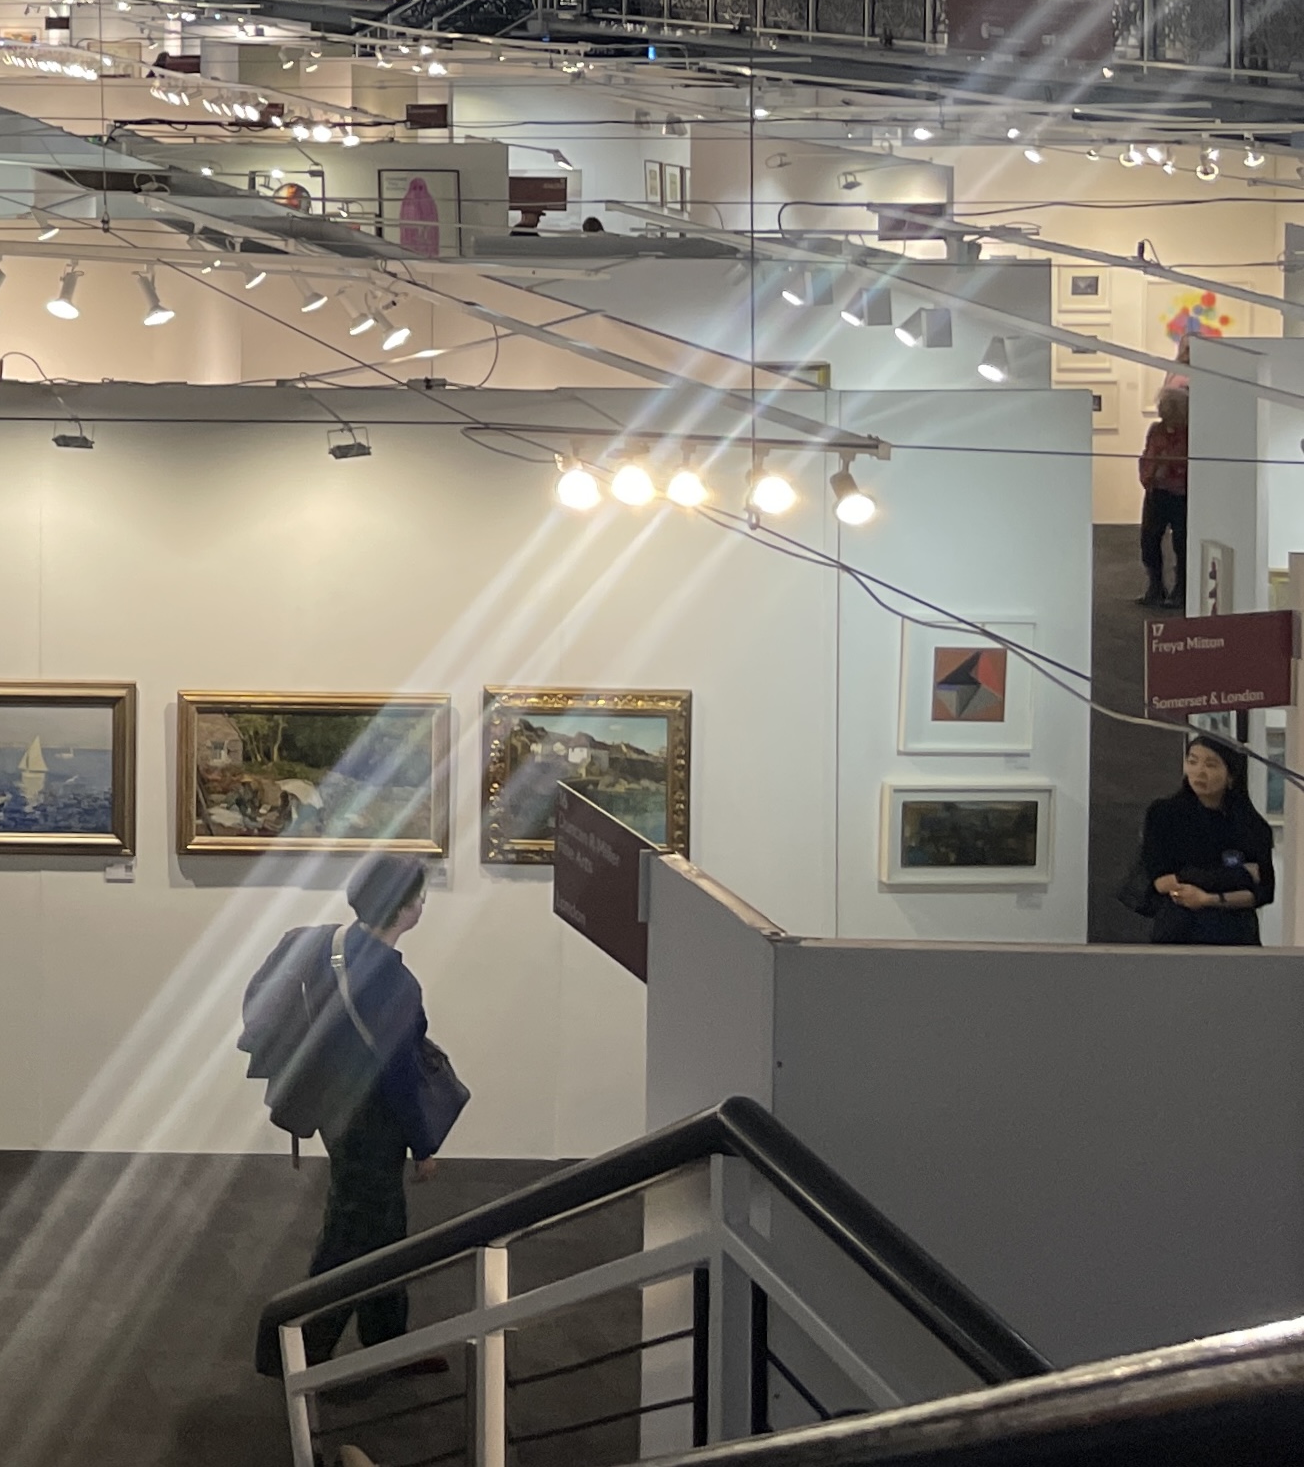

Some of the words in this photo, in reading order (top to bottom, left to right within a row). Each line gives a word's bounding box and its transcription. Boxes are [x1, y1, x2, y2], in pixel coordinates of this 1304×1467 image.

[1152, 623, 1165, 636] 17
[1152, 639, 1185, 654] Freya
[1152, 694, 1208, 710] Somerset
[1210, 691, 1218, 705] &
[1221, 689, 1264, 704] London
